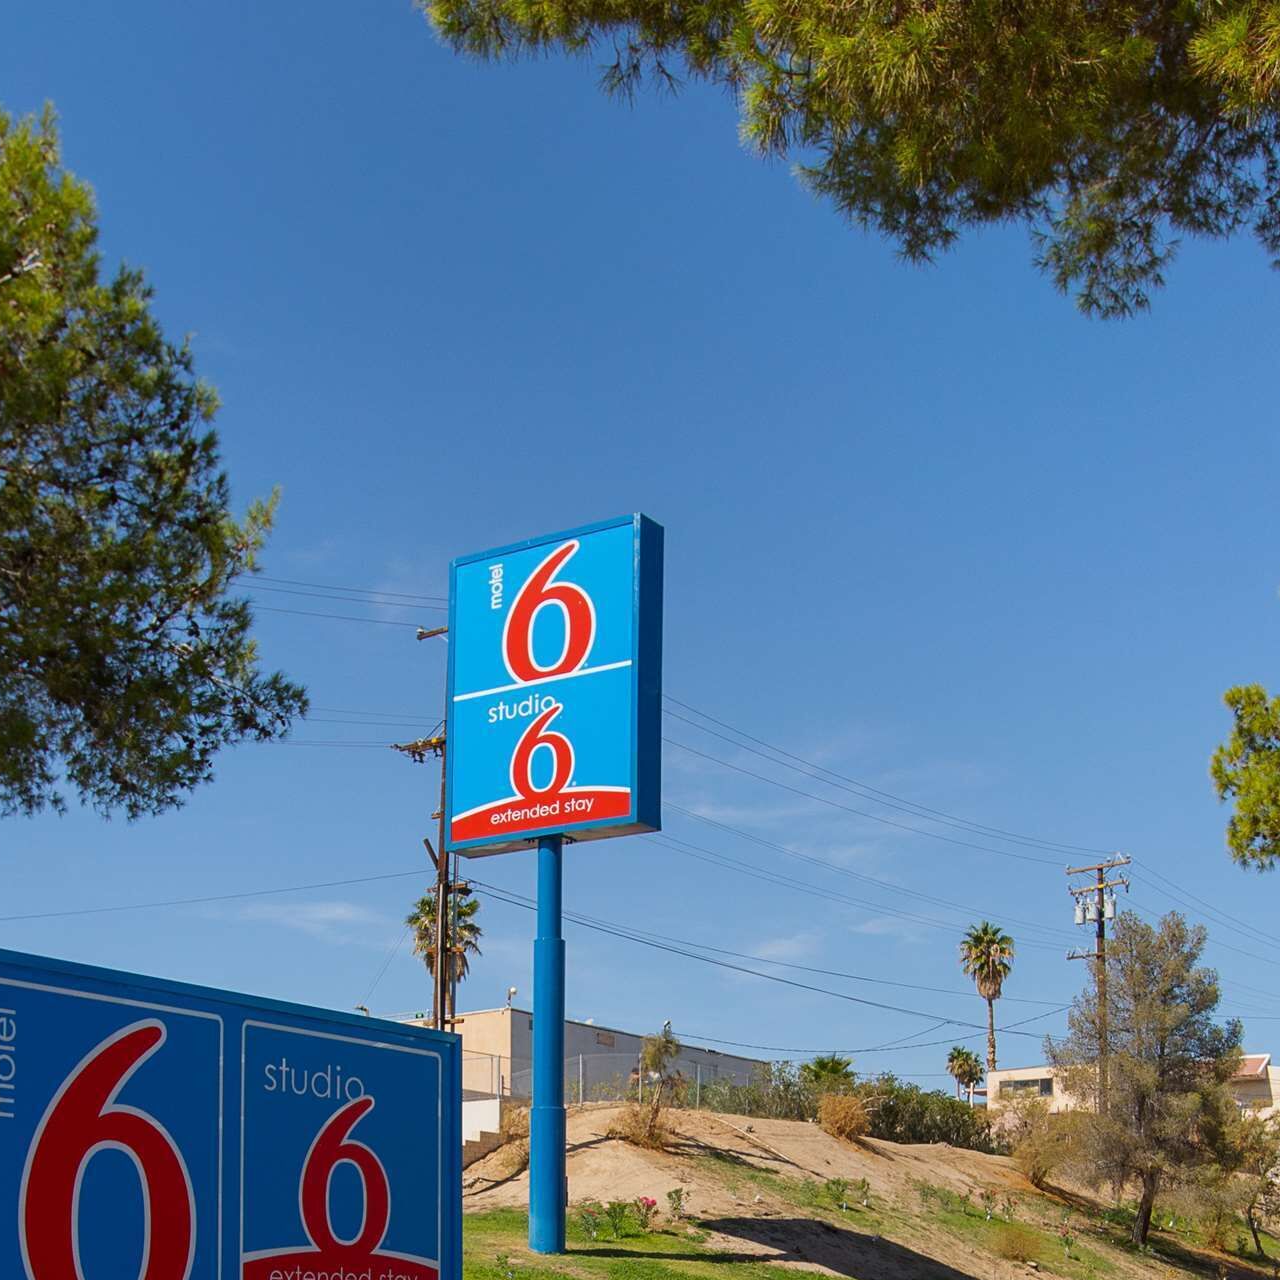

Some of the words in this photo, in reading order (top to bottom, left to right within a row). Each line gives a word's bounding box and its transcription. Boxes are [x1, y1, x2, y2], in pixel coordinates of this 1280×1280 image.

[489, 563, 503, 609] motel
[502, 539, 596, 683] 6
[488, 693, 556, 723] studio
[510, 702, 575, 799] 6
[490, 801, 560, 825] extended
[564, 797, 594, 813] stay
[264, 1057, 365, 1101] studio
[299, 1095, 391, 1254] 6
